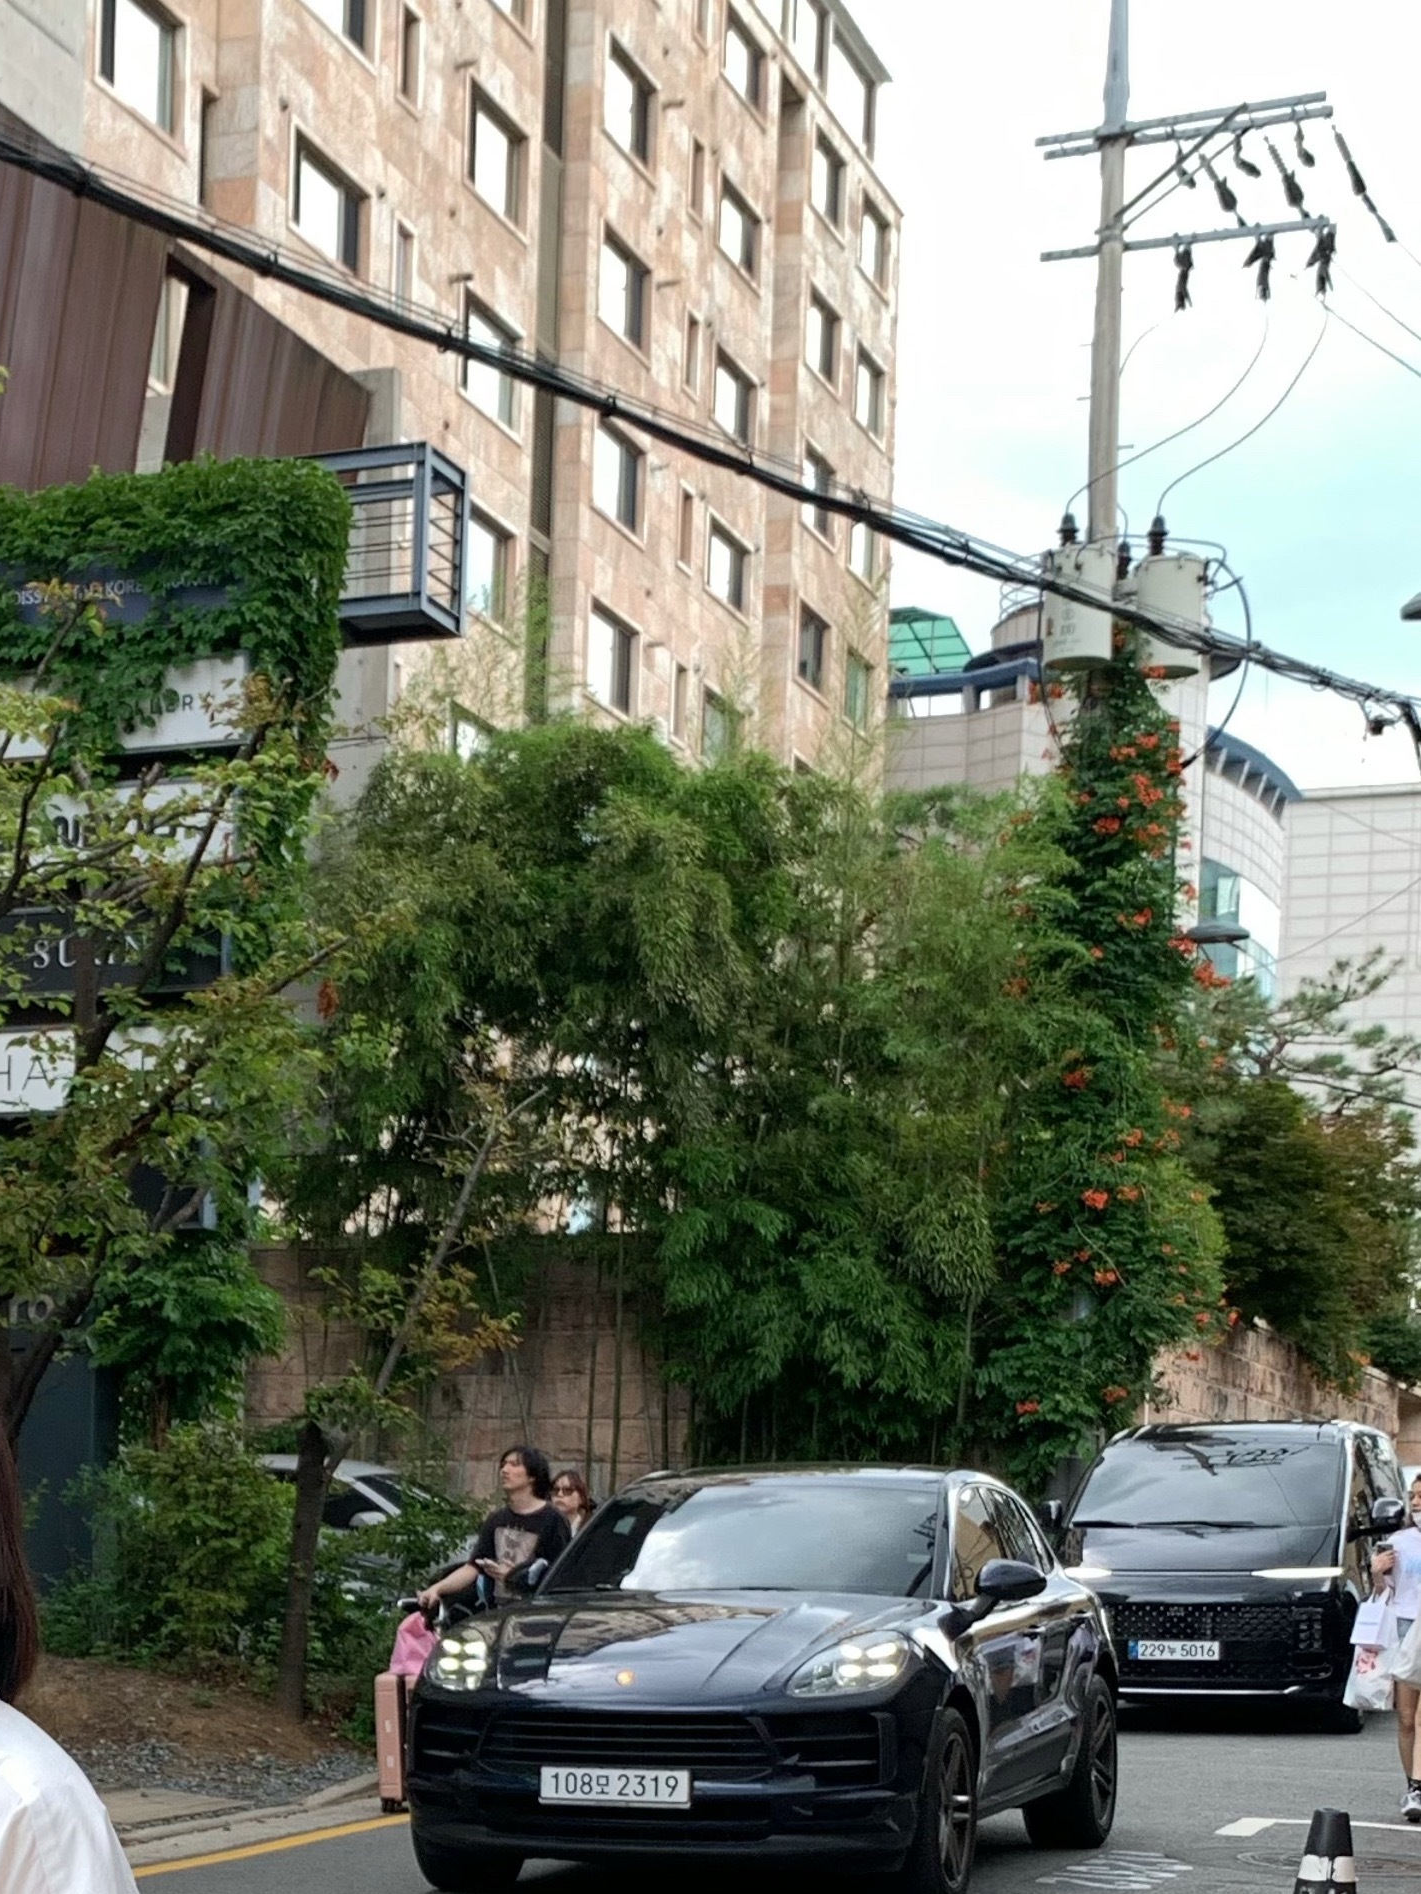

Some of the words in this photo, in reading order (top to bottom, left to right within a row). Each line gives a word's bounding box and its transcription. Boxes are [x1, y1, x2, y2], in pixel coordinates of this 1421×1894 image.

[1180, 1643, 1216, 1657] 5016
[550, 1771, 610, 1796] 108모
[617, 1773, 679, 1798] 2319
